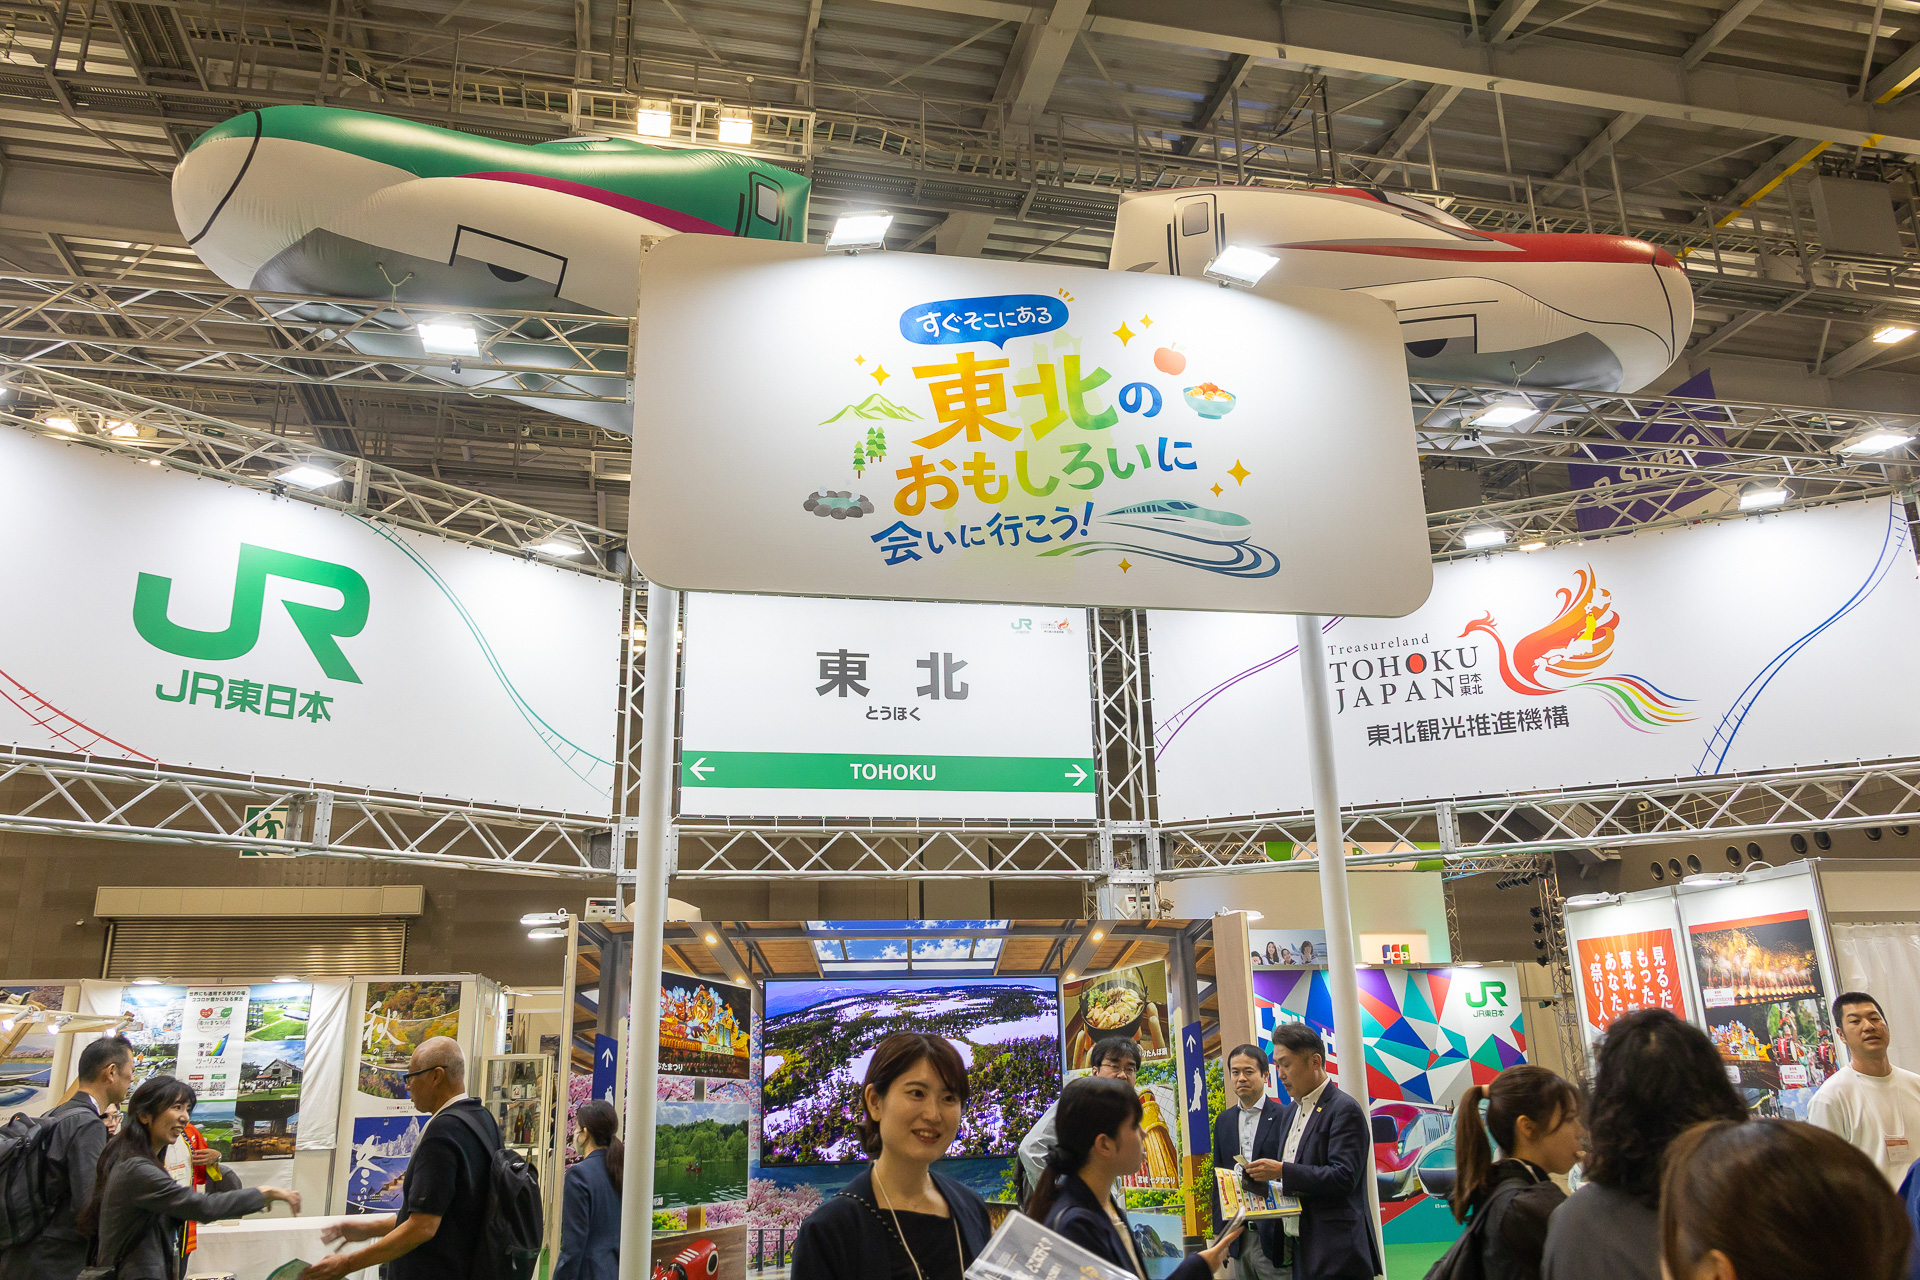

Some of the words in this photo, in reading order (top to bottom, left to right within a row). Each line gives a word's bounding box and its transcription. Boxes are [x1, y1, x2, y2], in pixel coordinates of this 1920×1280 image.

[916, 305, 1052, 337] すぐそこにある
[911, 352, 1163, 450] 東北の
[893, 436, 1198, 517] おもしろいに
[870, 501, 1095, 567] 会いに行こう!
[132, 542, 371, 685] JR
[1010, 618, 1033, 630] JR
[1327, 633, 1431, 656] Treasureland
[1329, 645, 1479, 684] TOHOKU
[1459, 673, 1483, 685] 日本
[155, 669, 334, 724] JR東日本
[1336, 675, 1456, 714] JAPAN
[1460, 684, 1484, 696] 東北
[865, 705, 921, 722] とうほく
[1366, 704, 1570, 747] 東北観光推進機構
[850, 762, 937, 781] TOHOKU
[1465, 981, 1509, 1008] JR
[1636, 947, 1656, 1009] もった
[1472, 1009, 1505, 1018] JR東日本
